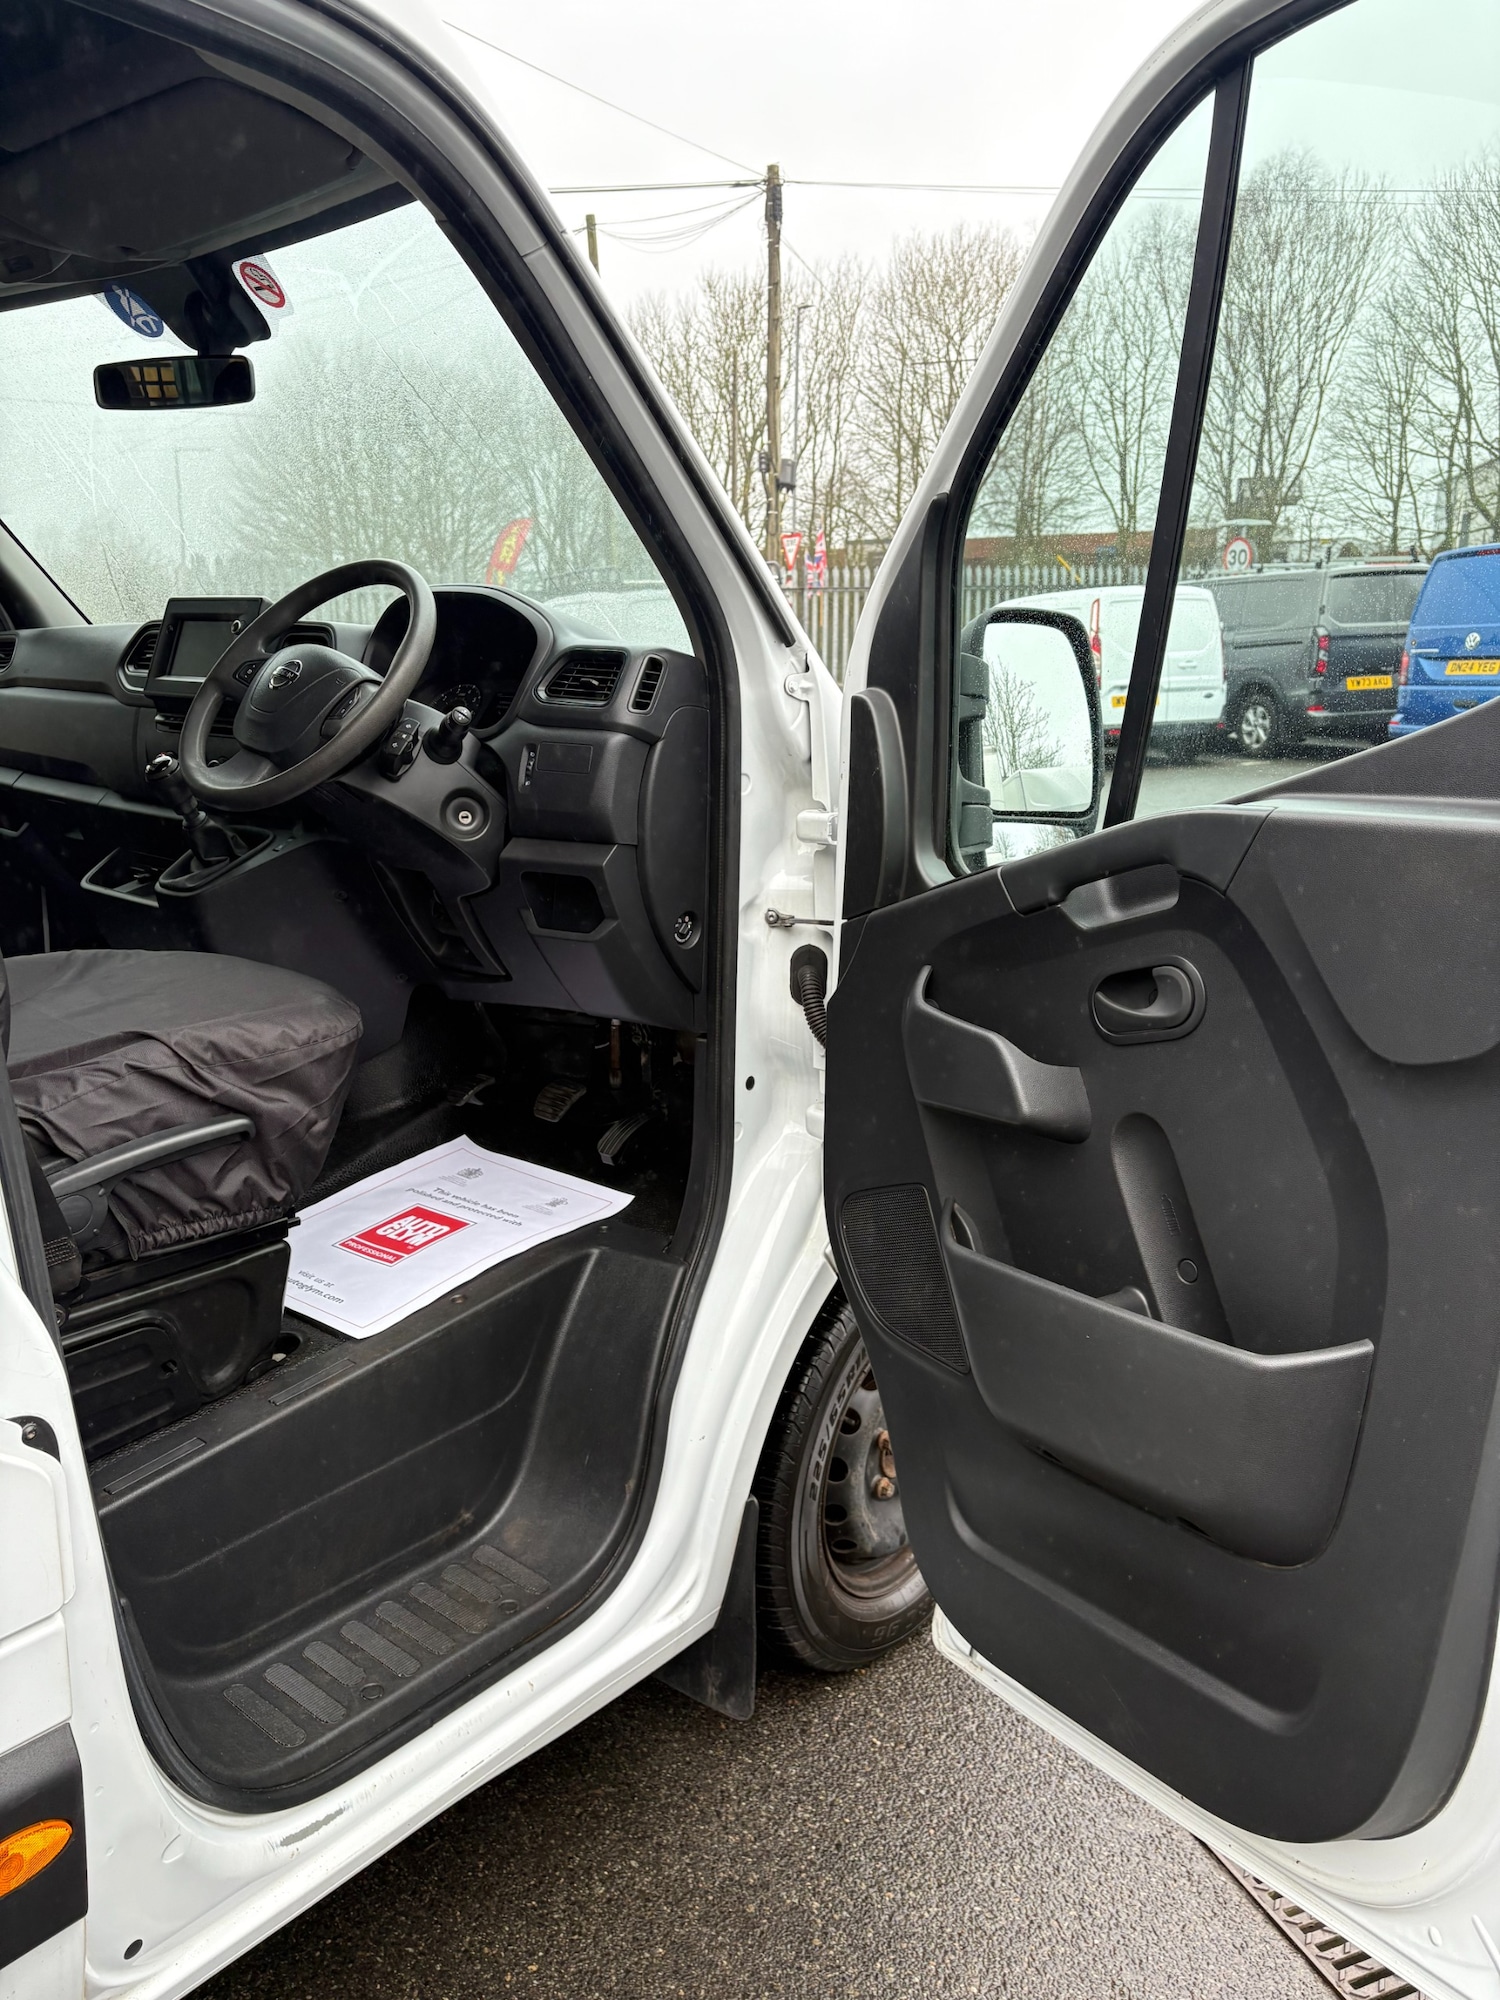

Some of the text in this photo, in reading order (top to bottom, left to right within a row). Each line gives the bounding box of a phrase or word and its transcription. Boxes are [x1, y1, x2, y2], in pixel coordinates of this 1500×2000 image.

[1228, 549, 1248, 566] 30
[1478, 662, 1497, 672] YEG
[405, 1187, 522, 1226] polished and protected with
[433, 1187, 451, 1196] This
[452, 1195, 480, 1206] vehicle
[481, 1204, 498, 1212] has
[496, 1209, 519, 1218] been
[376, 1223, 432, 1246] GLYM
[392, 1215, 450, 1238] AUTO
[344, 1240, 397, 1261] PROFESSIONAL
[298, 1270, 316, 1279] visit
[287, 1277, 344, 1304] utoglym.com
